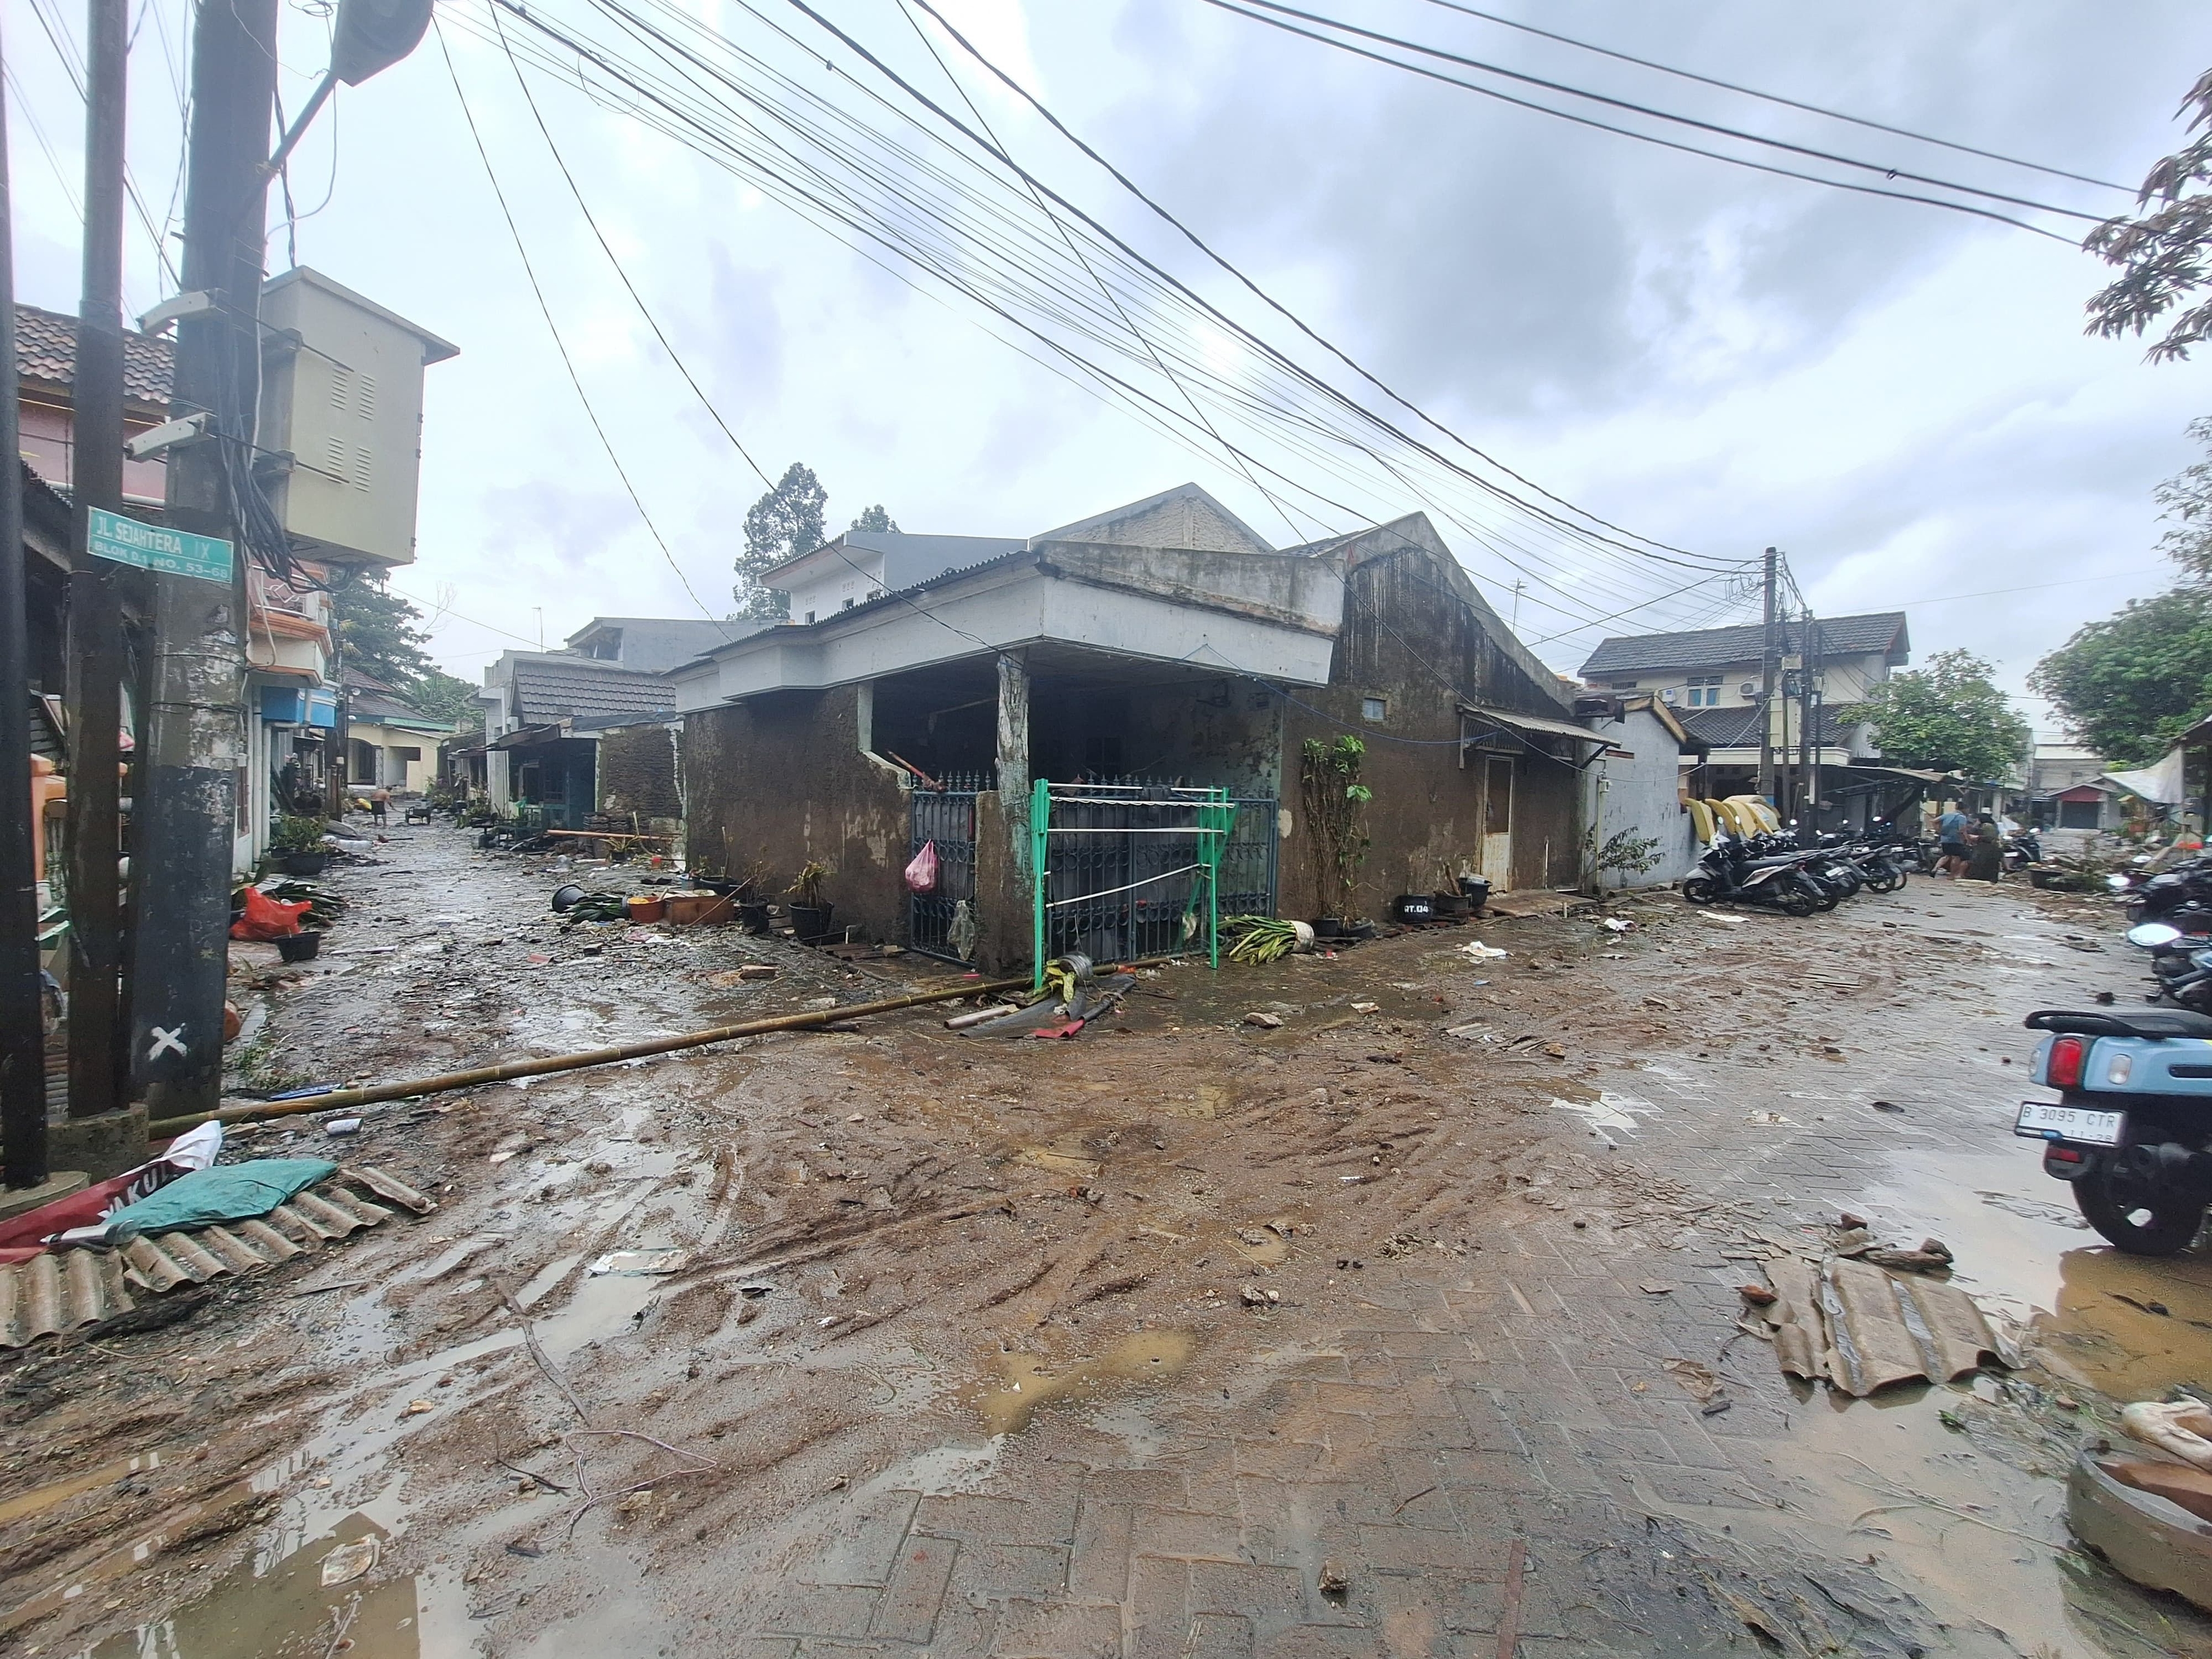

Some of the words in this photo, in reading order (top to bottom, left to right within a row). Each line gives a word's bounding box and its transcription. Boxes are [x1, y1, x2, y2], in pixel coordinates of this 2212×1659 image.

[94, 540, 128, 559] BLOK
[153, 557, 181, 570] NO.
[186, 562, 228, 578] 53-68
[115, 521, 182, 554] SEJAHTERA
[195, 540, 210, 560] IX
[2022, 1106, 2032, 1118] B
[2039, 1108, 2076, 1123] 3095
[2086, 1113, 2115, 1127] CTR
